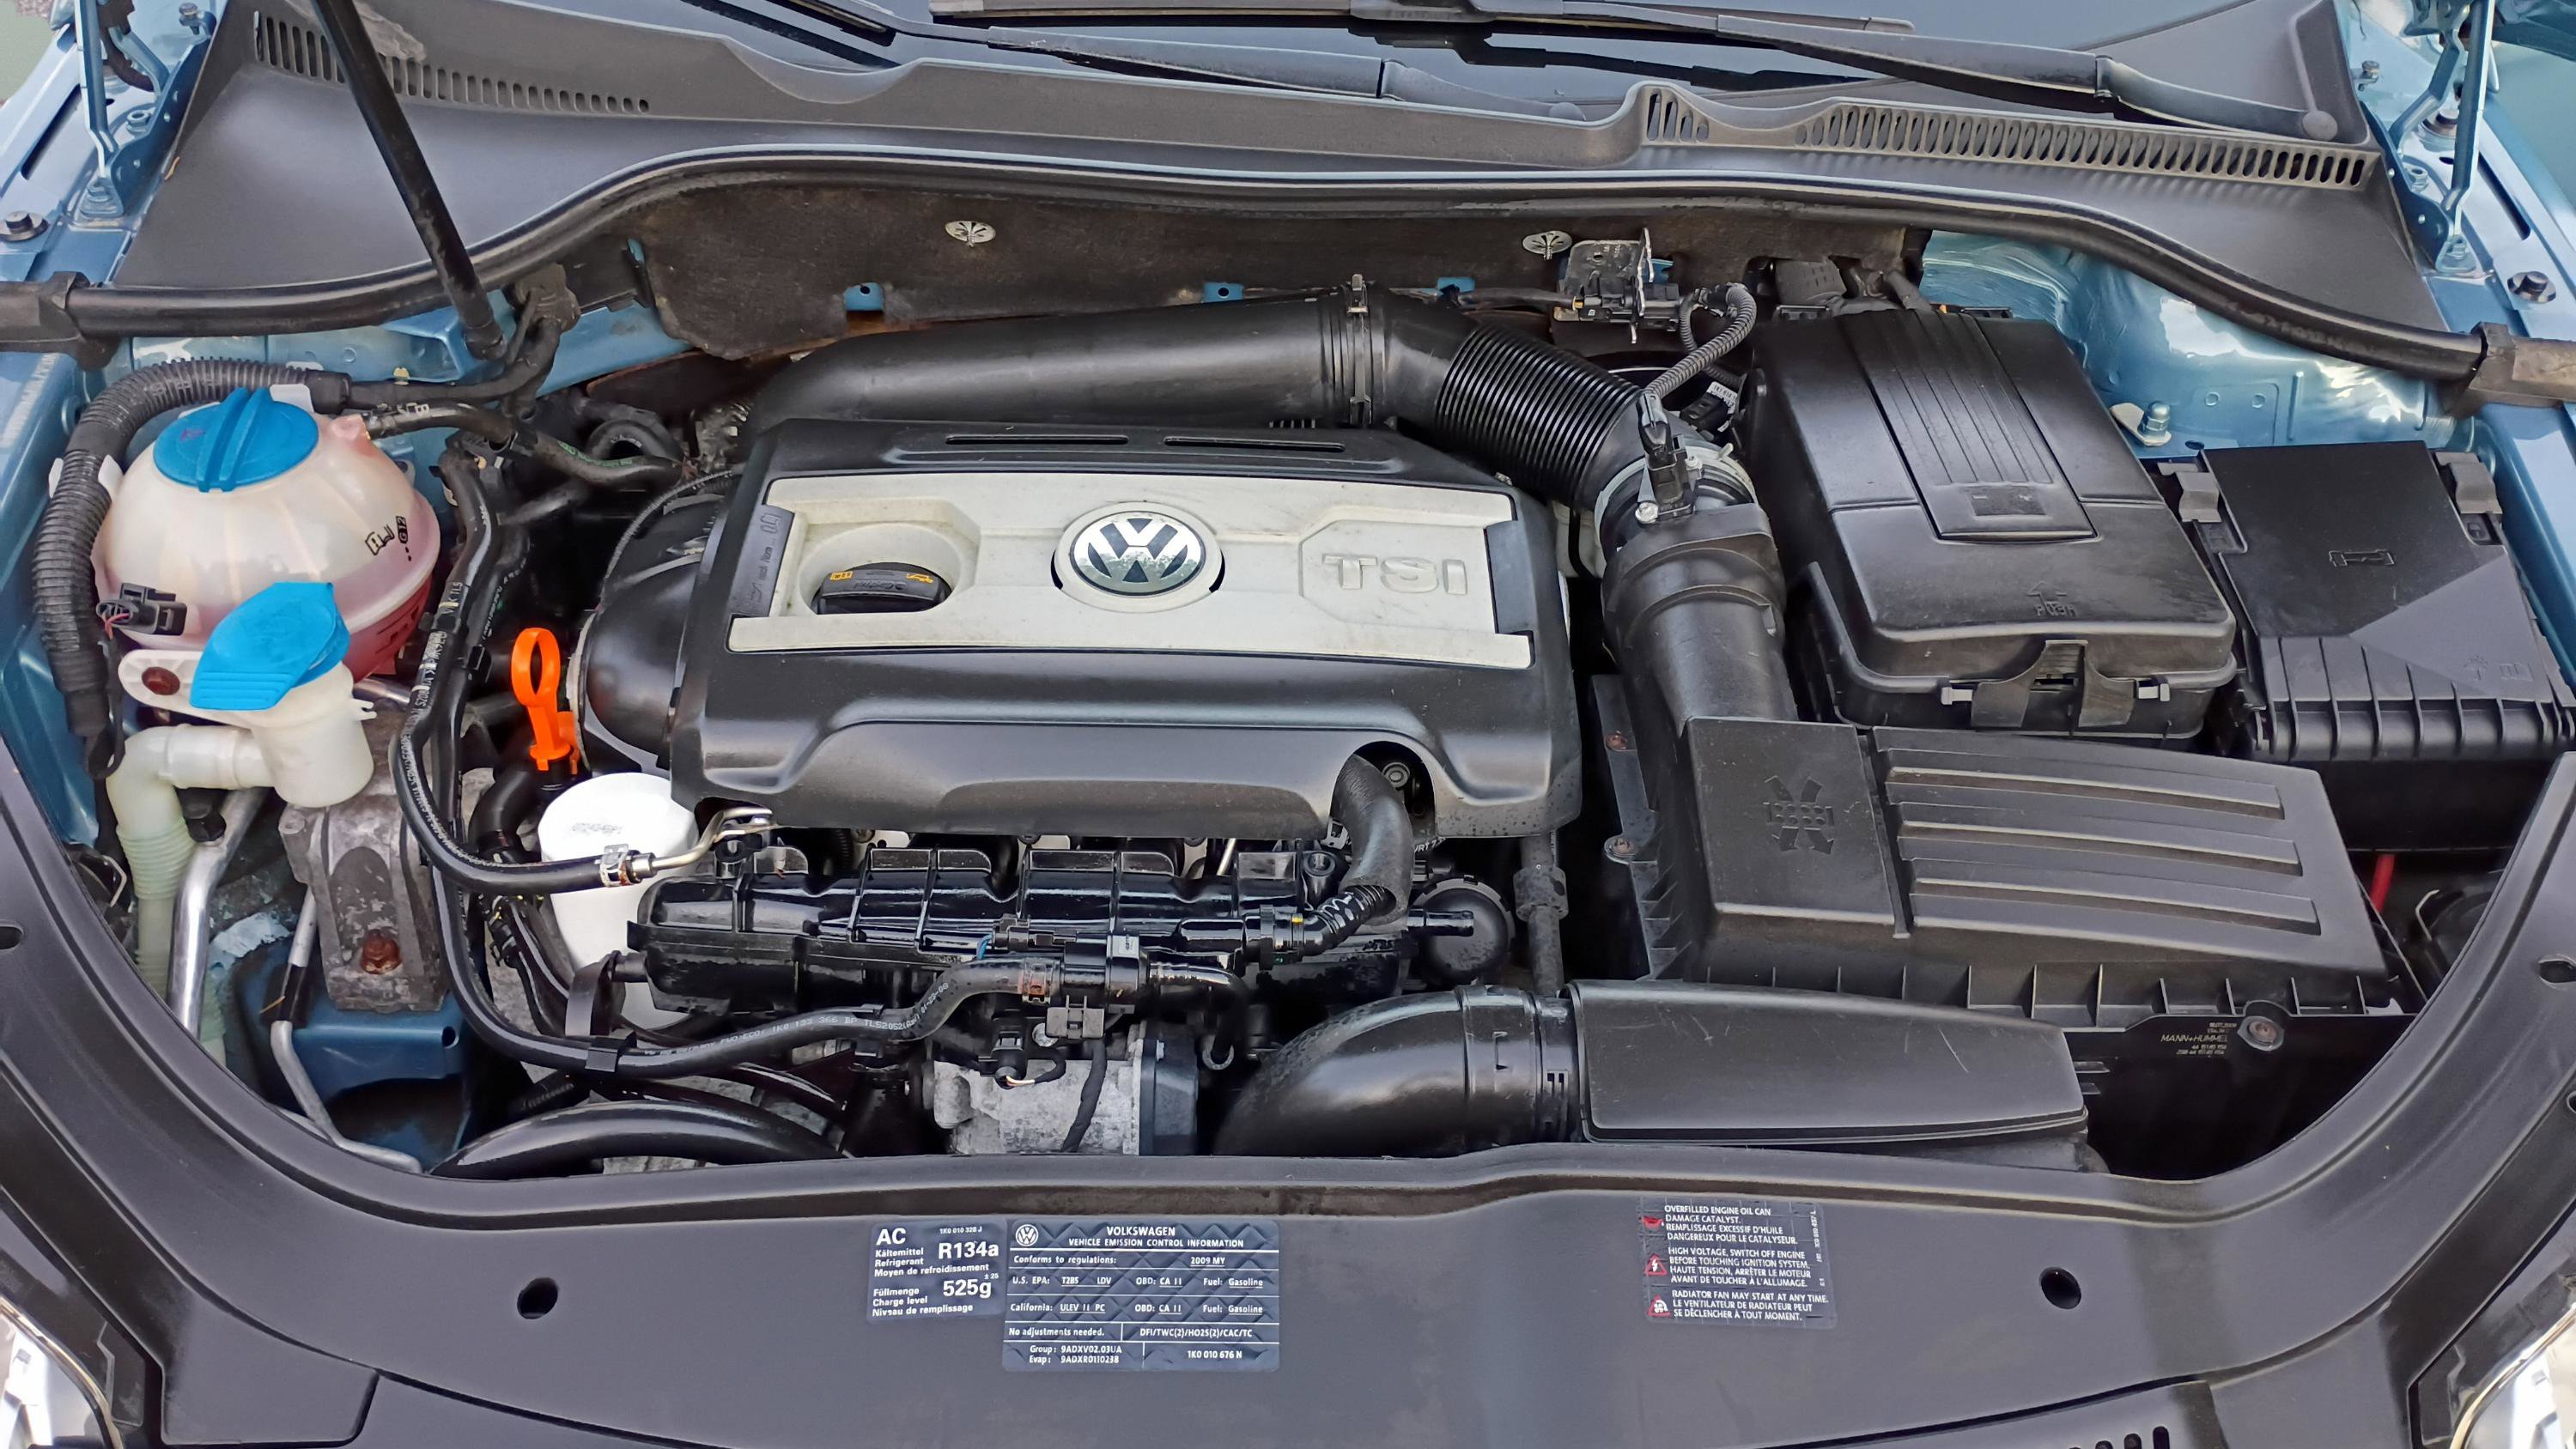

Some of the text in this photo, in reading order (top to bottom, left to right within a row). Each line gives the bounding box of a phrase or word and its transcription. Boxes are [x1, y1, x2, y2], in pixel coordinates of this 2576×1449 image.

[1321, 553, 1468, 595] TSI
[1664, 1204, 1771, 1216] OVERFILLED ENGINE OIL CAN
[1665, 1214, 1741, 1224] DAMAGE CATALYST.
[1106, 1226, 1176, 1237] VOLKSWAGEN
[1666, 1223, 1783, 1234] REMPLISSAGE EXCESSIF D'HUILE
[876, 1228, 906, 1246] AC
[1667, 1232, 1799, 1245] DANGEREUX POUR LE CATALYSEUR.
[1068, 1238, 1244, 1248] VEHICLE EMISSION CONTROL INFORMATION
[875, 1247, 924, 1258] Kältemittel
[938, 1241, 999, 1259] R134a
[1668, 1246, 1689, 1255] HIGH
[1729, 1249, 1759, 1258] SWITCH
[1760, 1250, 1776, 1258] OFF
[1777, 1251, 1806, 1259] ENGINE
[874, 1258, 925, 1268] Refrigerant
[1013, 1255, 1117, 1265] Conforms to regulations:
[1190, 1256, 1226, 1265] 2009 MY
[1669, 1256, 1811, 1270] BEFORE TOUCHING IGNITION SYSTEM.
[874, 1268, 904, 1278] Moyen
[920, 1264, 990, 1275] refroidissement
[1669, 1265, 1696, 1274] HAUTE
[1768, 1269, 1777, 1277] LE
[1778, 1270, 1812, 1278] MOTEUR
[1012, 1276, 1050, 1285] U.S. EPA:
[1061, 1276, 1112, 1285] T2B5 LDV
[1135, 1276, 1157, 1286] OBD:
[1159, 1276, 1171, 1285] CA
[1203, 1277, 1264, 1287] Fuel: Gasoline
[1670, 1275, 1698, 1283] AVANT
[1700, 1276, 1710, 1284] DE
[1711, 1276, 1747, 1285] TOUCHER
[1756, 1277, 1808, 1288] L'ALLUMAGE.
[873, 1288, 920, 1297] Füllmenge
[943, 1279, 992, 1299] 525g
[872, 1297, 904, 1307] Charge
[1672, 1289, 1830, 1304] RADIATOR FAN MAY START AT ANY TIME.
[872, 1307, 903, 1317] Niveau
[919, 1304, 974, 1315] remplissage
[1010, 1302, 1054, 1313] California:
[1060, 1303, 1079, 1312] ULEV
[1094, 1303, 1106, 1313] PC
[1134, 1304, 1156, 1313] OBD:
[1158, 1304, 1170, 1313] CA
[1202, 1304, 1264, 1314] Fuel: Gasoline
[1684, 1300, 1736, 1308] VENTILATEUR
[1736, 1300, 1747, 1309] DE
[1748, 1301, 1793, 1311] RADIATEUR
[1793, 1302, 1814, 1313] PEUT
[1674, 1309, 1683, 1318] SE
[1741, 1310, 1763, 1319] TOUT
[1765, 1311, 1804, 1322] MOMENT.
[1008, 1327, 1105, 1338] No adjustments needed.
[1188, 1349, 1242, 1359] 1K0 010 676 N
